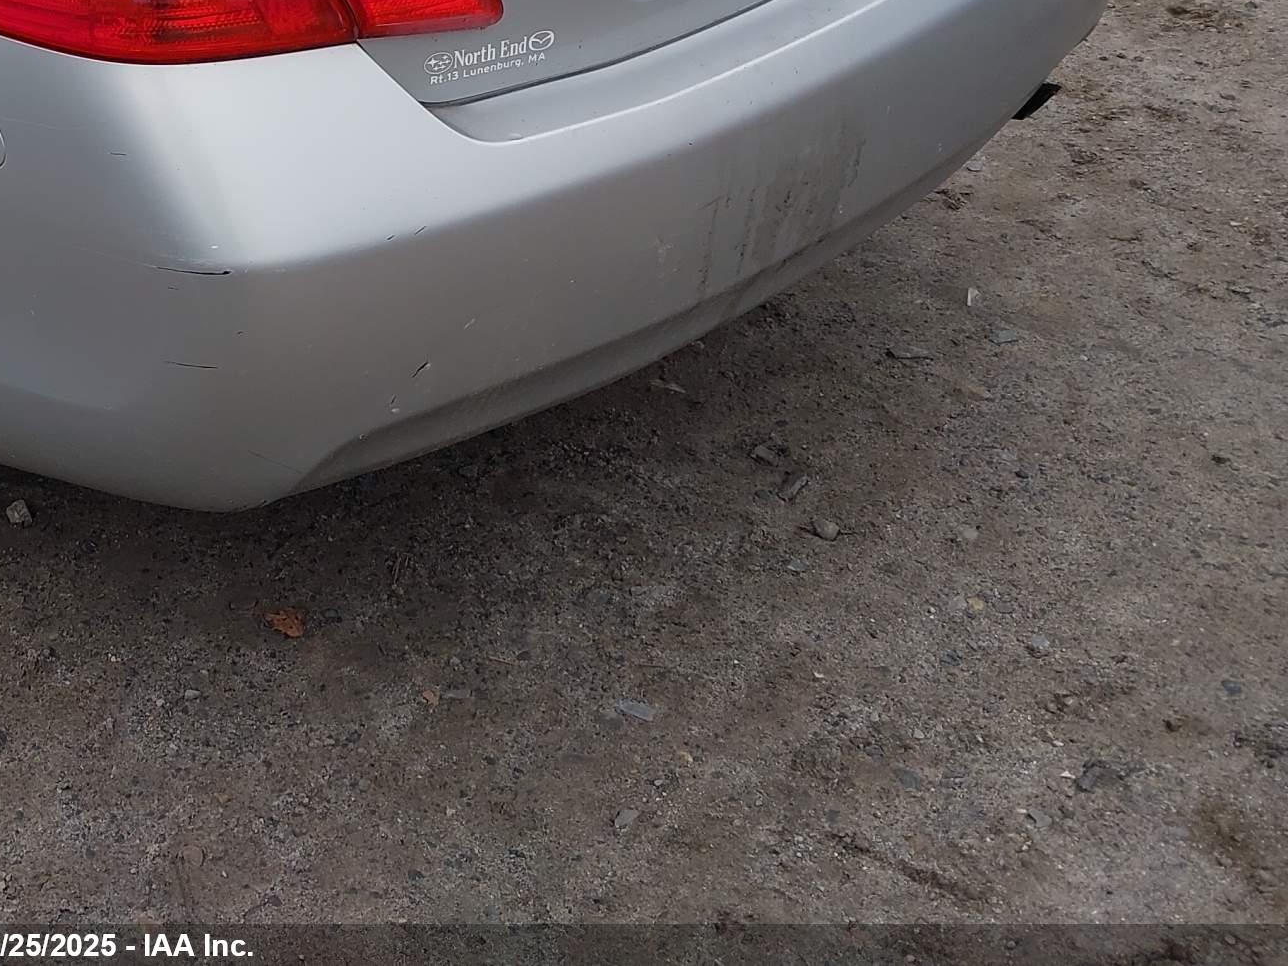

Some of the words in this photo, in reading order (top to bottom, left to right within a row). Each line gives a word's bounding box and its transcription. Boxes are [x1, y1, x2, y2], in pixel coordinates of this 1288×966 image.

[453, 43, 496, 68] North
[500, 36, 527, 58] End
[430, 71, 459, 85] Rt.13
[463, 58, 524, 78] Lunenburg,
[528, 52, 546, 63] MA
